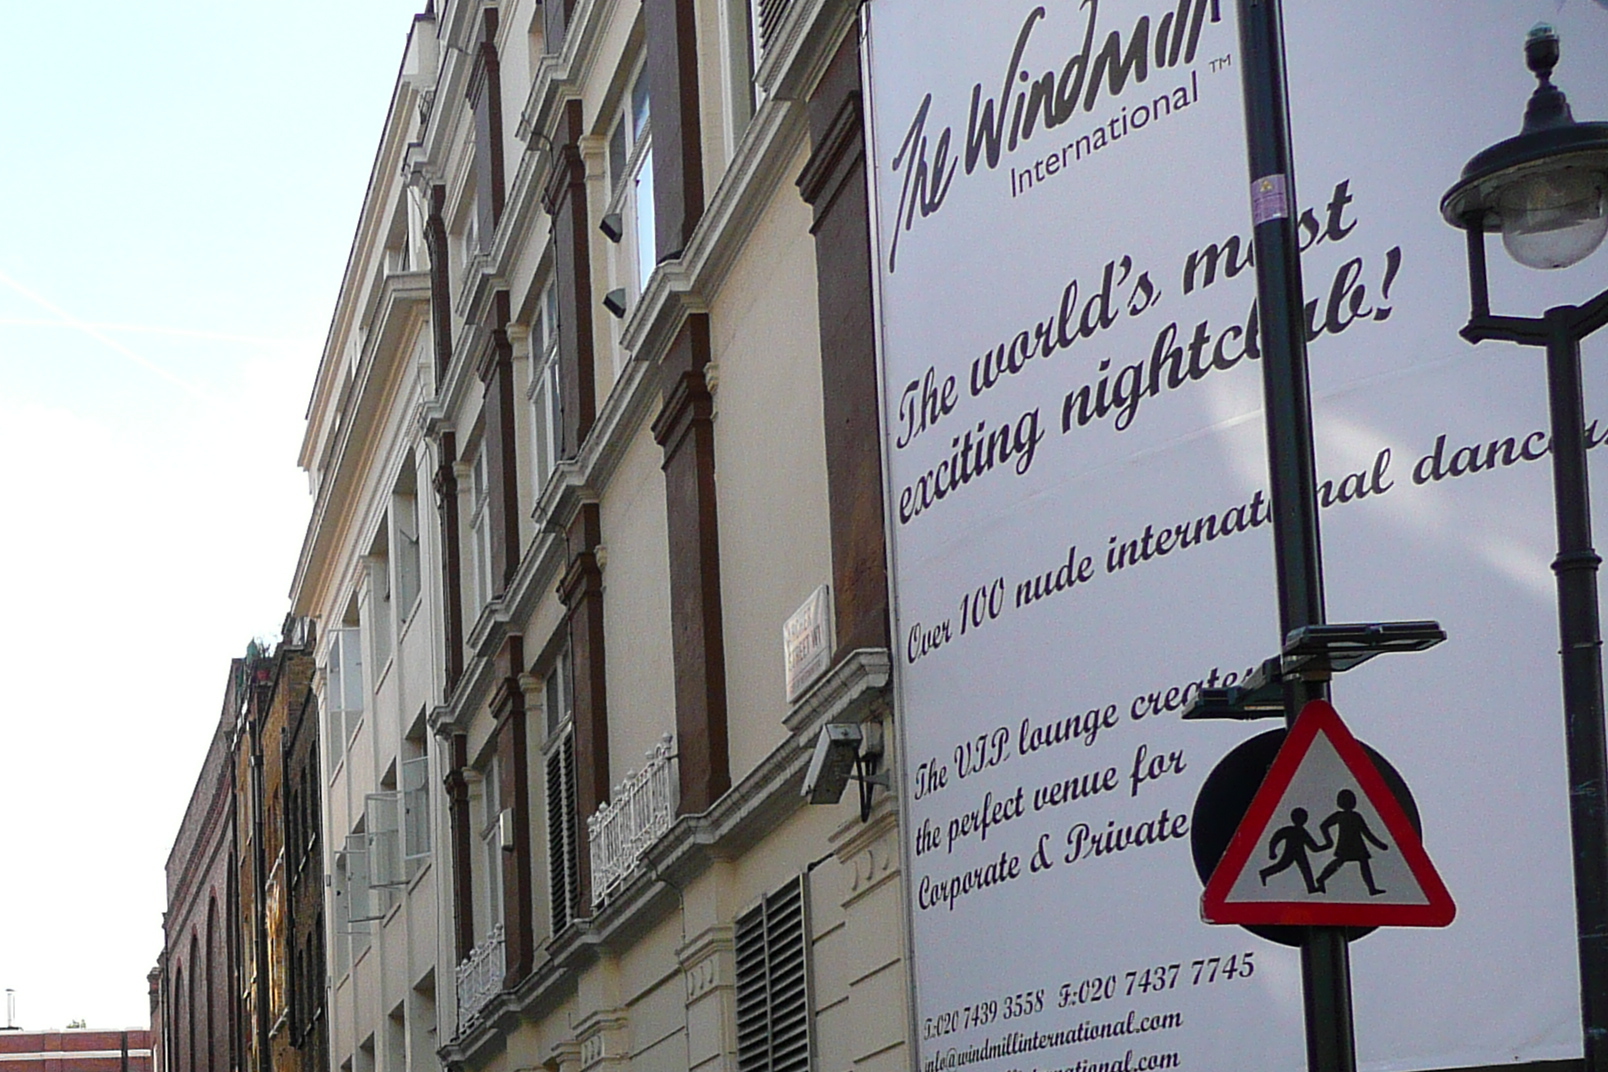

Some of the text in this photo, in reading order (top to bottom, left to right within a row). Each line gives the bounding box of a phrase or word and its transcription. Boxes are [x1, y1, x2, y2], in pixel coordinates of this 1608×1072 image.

[889, 93, 958, 273] The
[1010, 70, 1198, 198] International
[897, 178, 1357, 449] The world's mst
[899, 407, 1045, 525] exciting
[907, 417, 1608, 665] Over 100 nude internatnal dancr
[914, 757, 948, 800] The
[1019, 703, 1119, 755] lounge
[916, 744, 1187, 856] the perfect venue for
[918, 808, 1189, 911] Corporate & Private
[962, 1000, 998, 1031] 7439
[1003, 989, 1045, 1020] 3558
[1124, 964, 1181, 997] 7437
[1191, 952, 1256, 986] 7745
